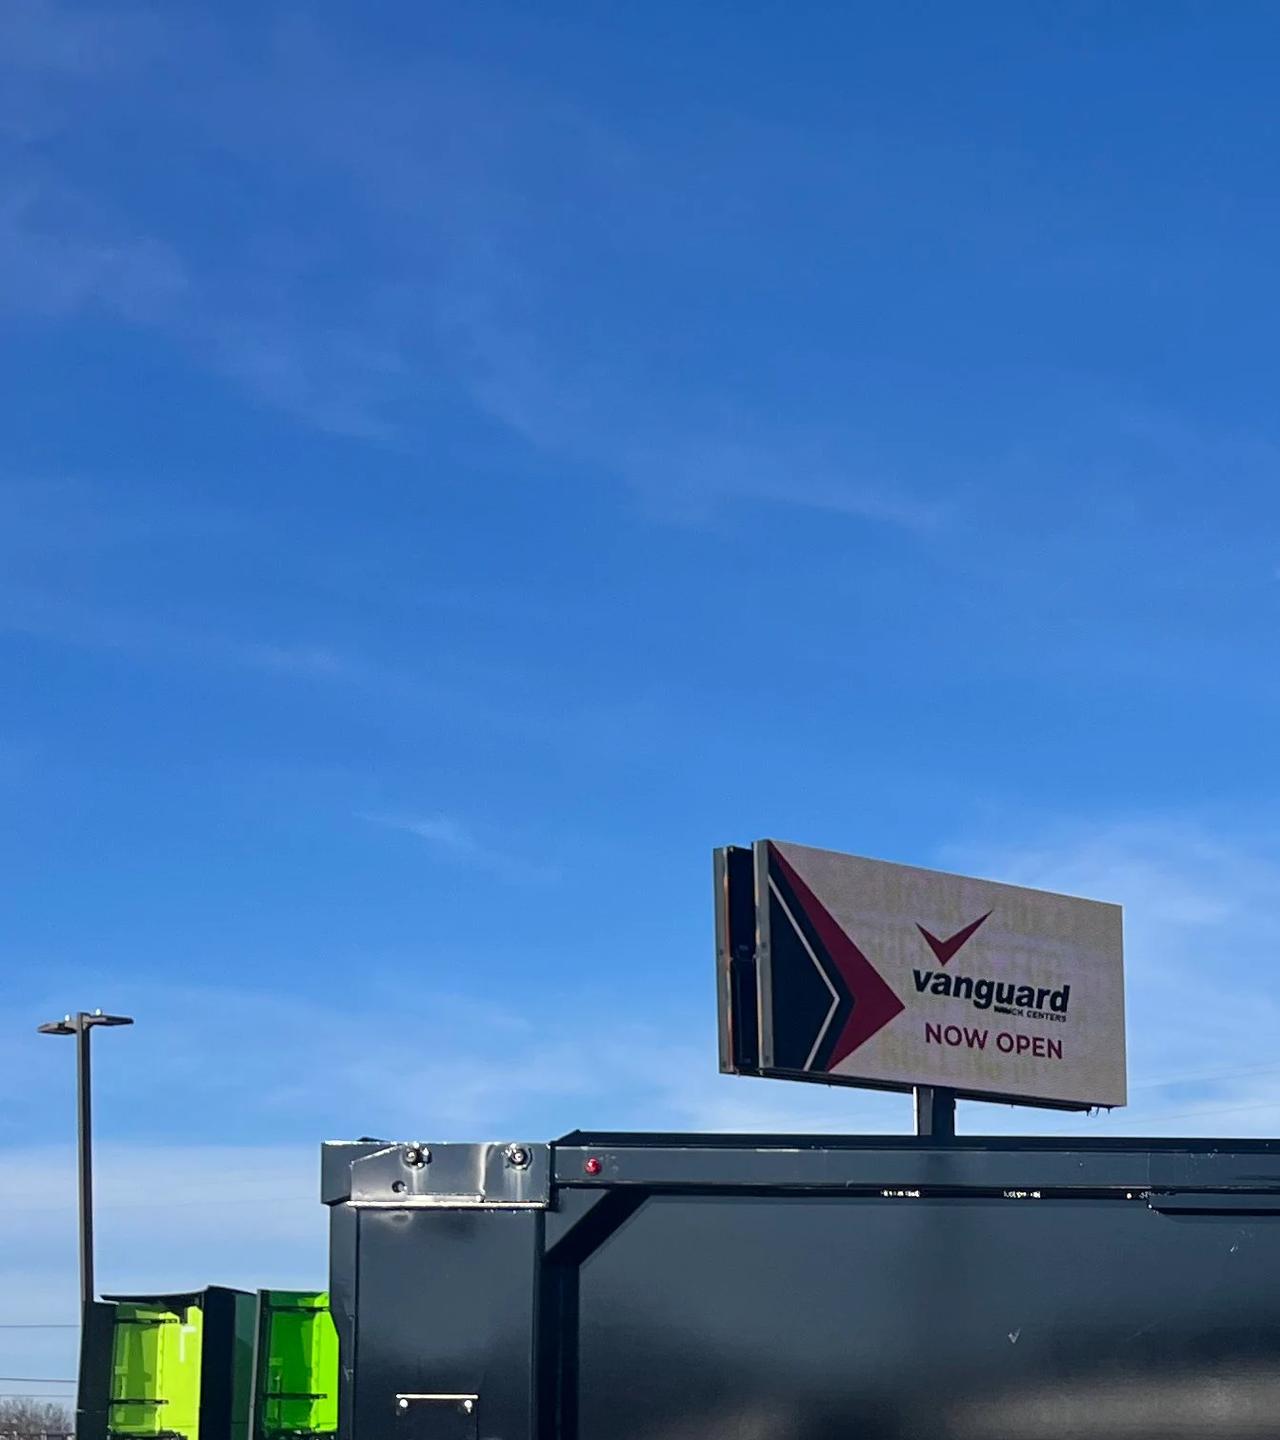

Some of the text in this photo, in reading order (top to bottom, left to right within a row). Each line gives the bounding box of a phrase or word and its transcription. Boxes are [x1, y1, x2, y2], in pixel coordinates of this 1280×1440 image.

[913, 969, 1070, 1013] vanguard
[925, 1022, 1062, 1060] NOW OPEN
